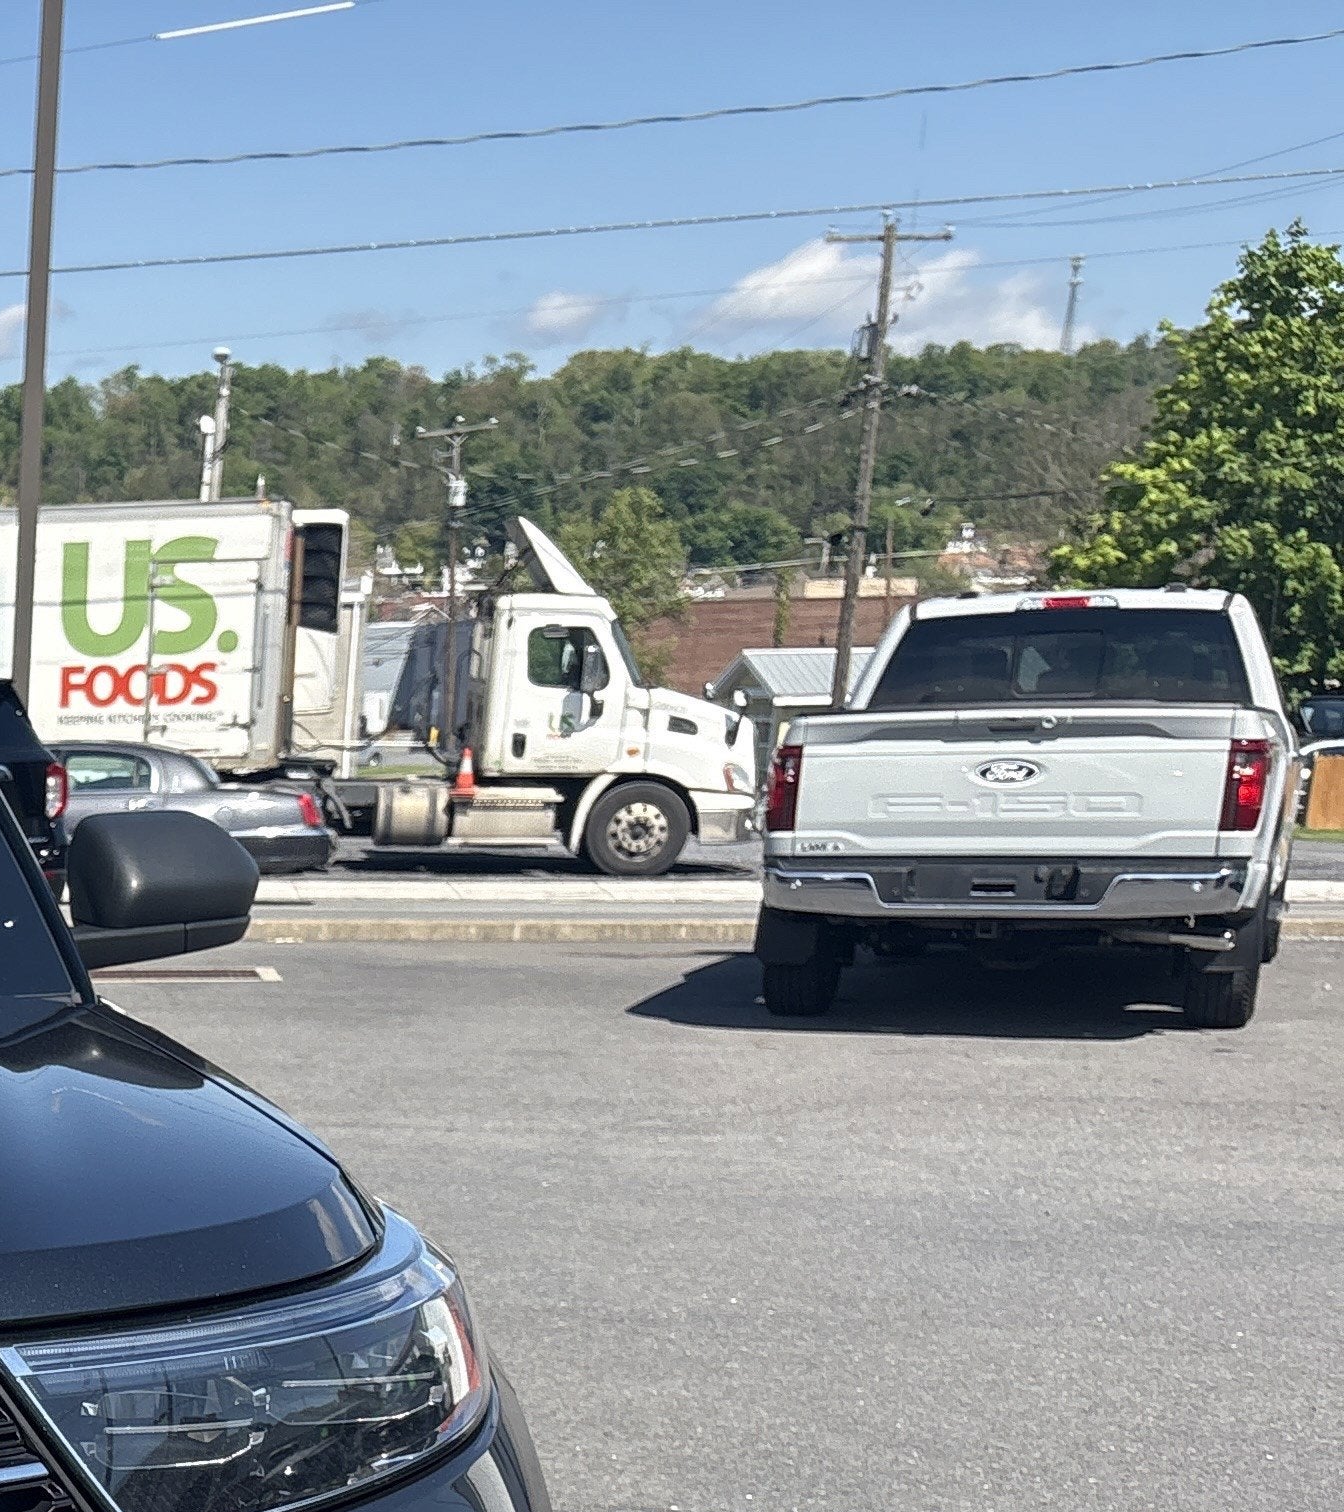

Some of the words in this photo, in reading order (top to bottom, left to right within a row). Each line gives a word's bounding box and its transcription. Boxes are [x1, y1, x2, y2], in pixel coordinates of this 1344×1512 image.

[60, 662, 219, 708] FOODS
[985, 762, 1030, 780] Ford
[868, 791, 1144, 818] F-150
